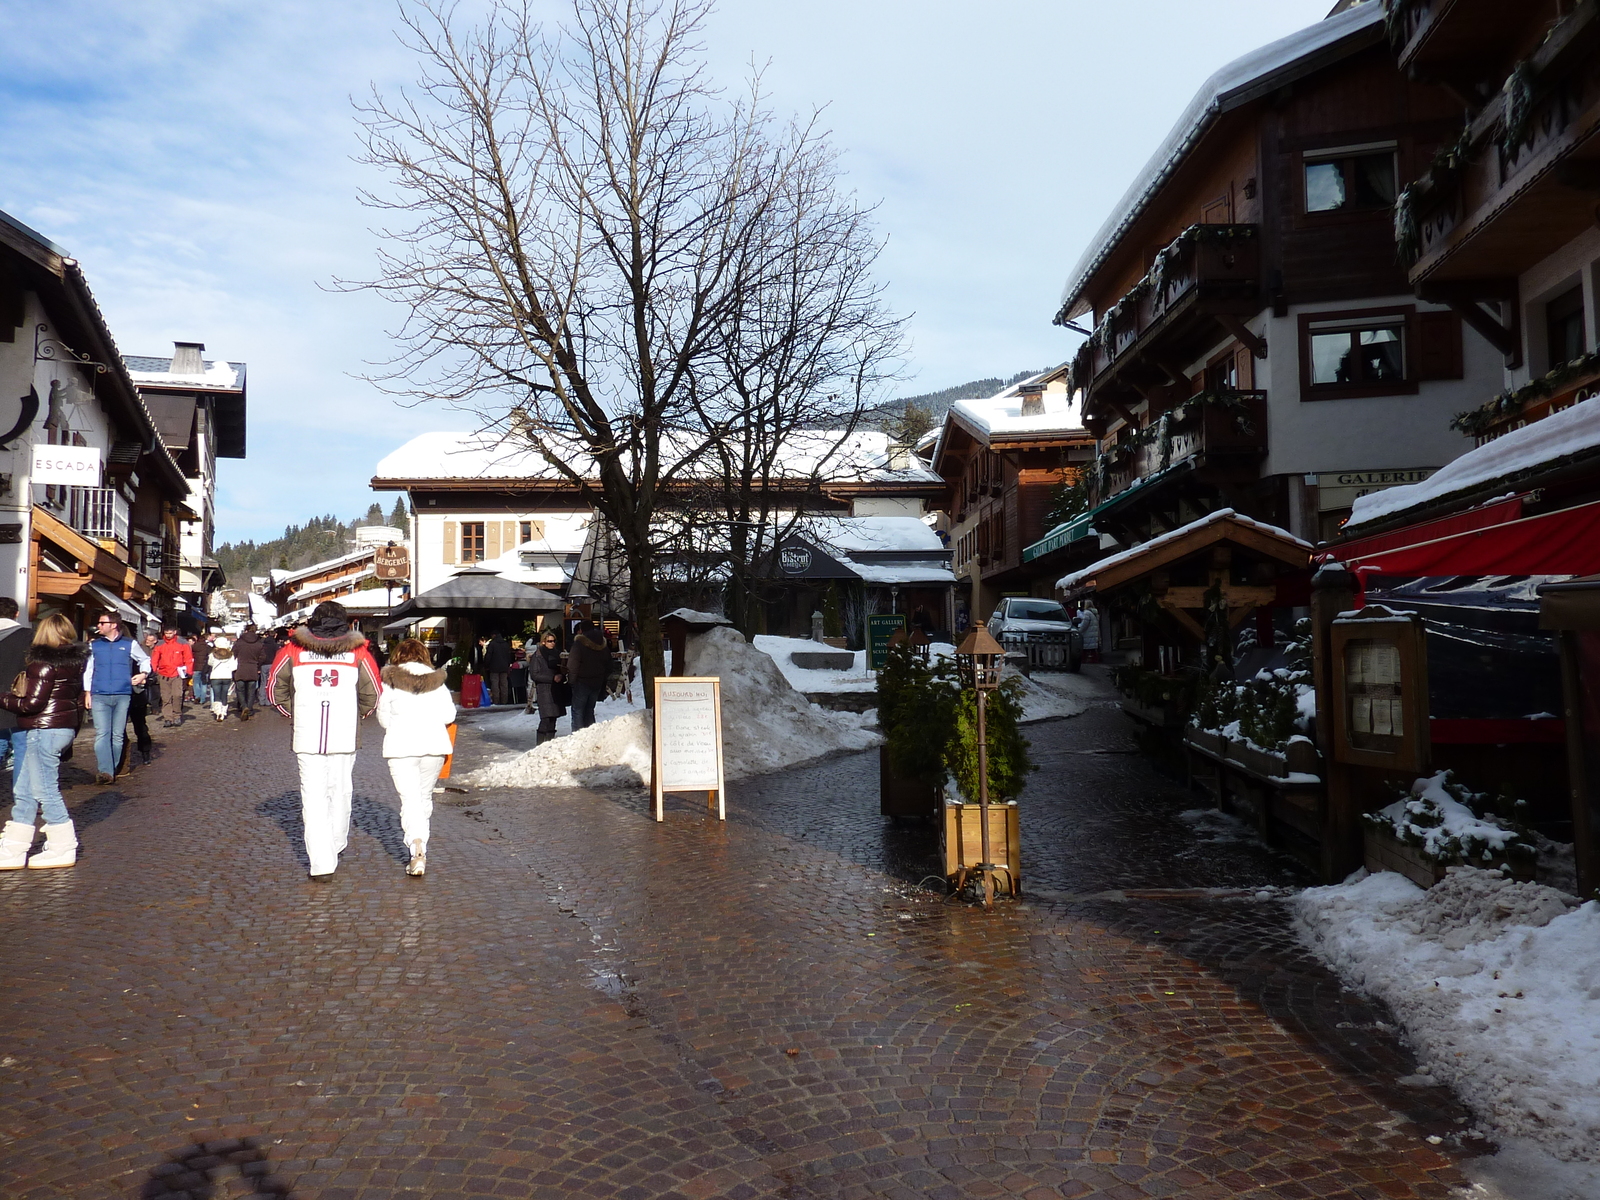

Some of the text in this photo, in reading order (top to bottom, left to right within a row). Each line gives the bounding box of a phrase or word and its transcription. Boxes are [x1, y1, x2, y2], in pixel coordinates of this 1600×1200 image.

[36, 459, 95, 471] ESCADA
[1338, 471, 1428, 485] GALERIE
[376, 556, 407, 567] BERGERIE
[781, 551, 809, 563] Bistrot
